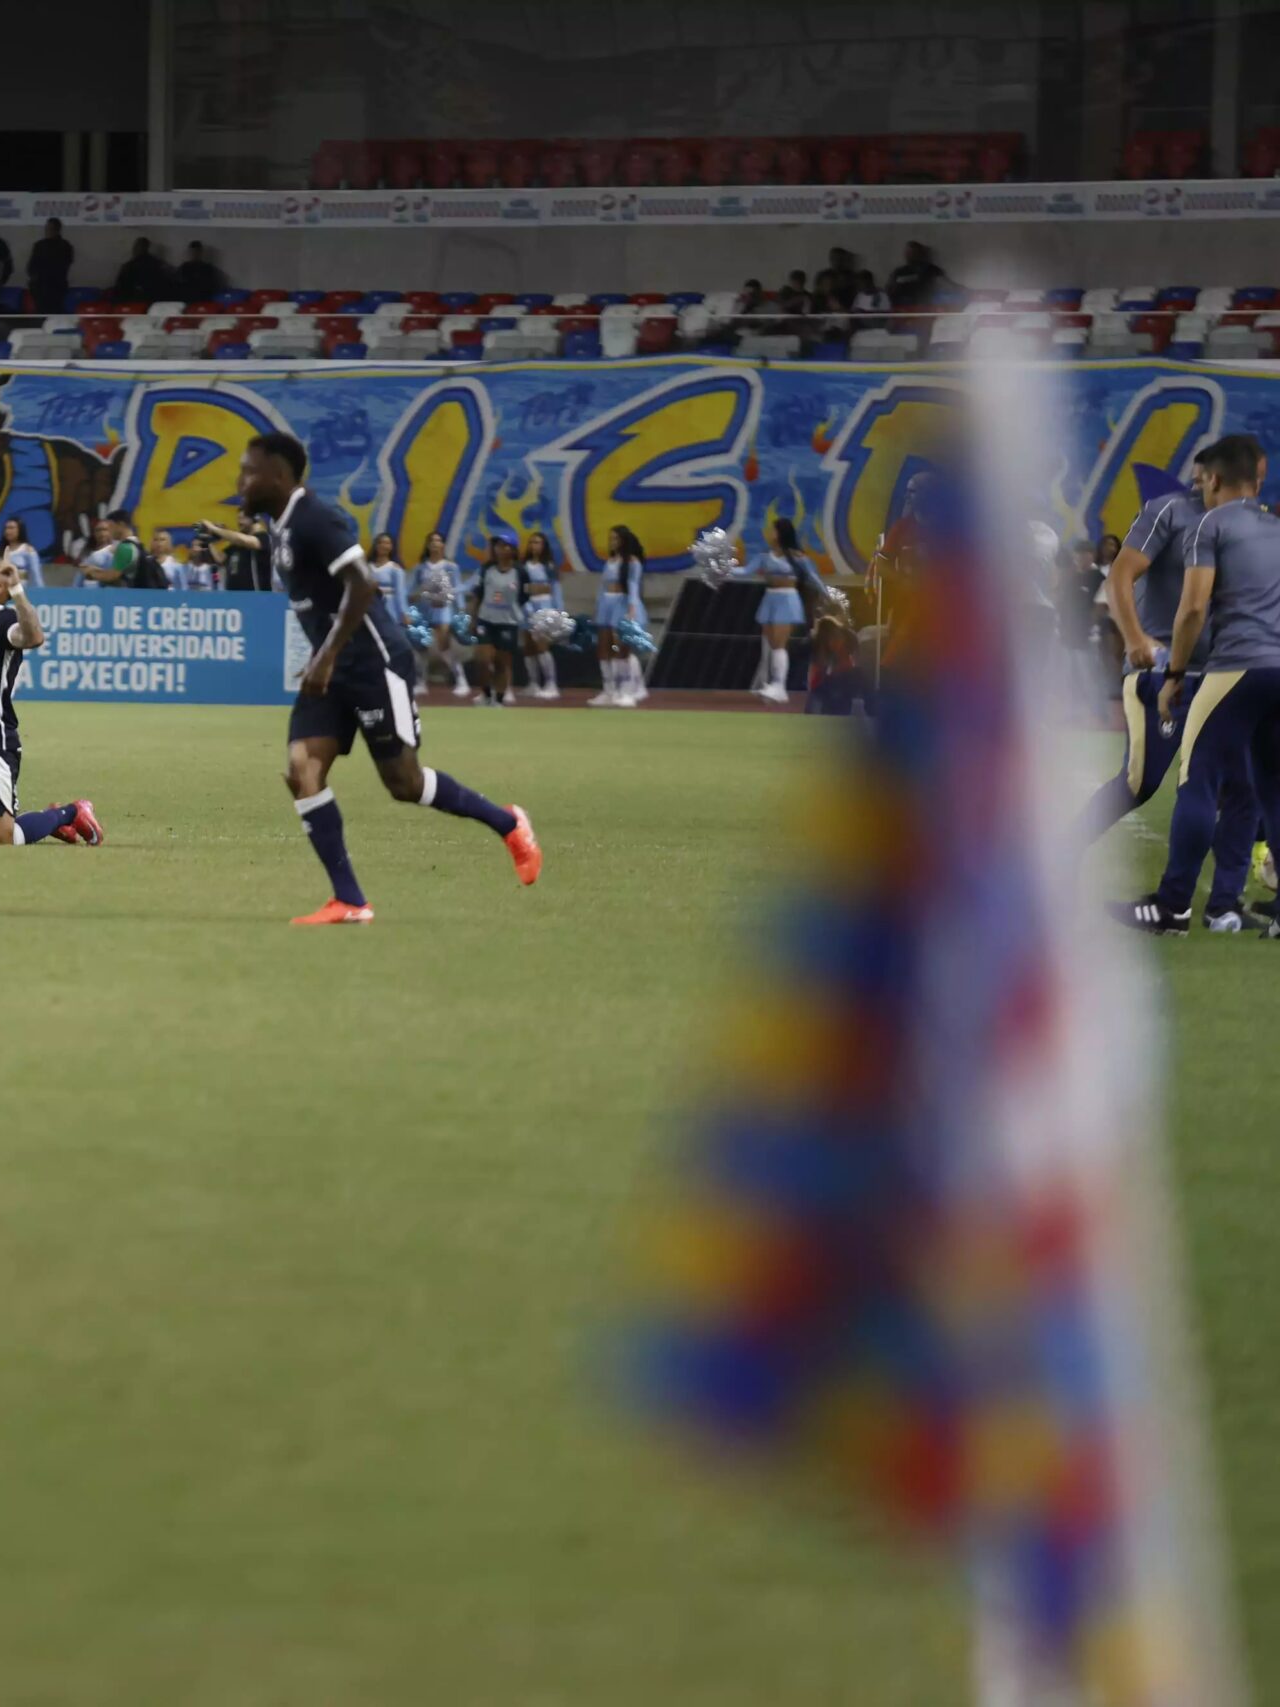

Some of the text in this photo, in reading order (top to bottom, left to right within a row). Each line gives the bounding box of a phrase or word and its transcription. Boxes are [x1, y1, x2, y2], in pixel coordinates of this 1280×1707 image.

[10, 603, 102, 631] OJETO
[113, 605, 143, 630] DE
[147, 603, 243, 633] CRÉDITO
[57, 632, 246, 661] BIODIVERSIDADE
[40, 659, 186, 693] GPXECOFI!
